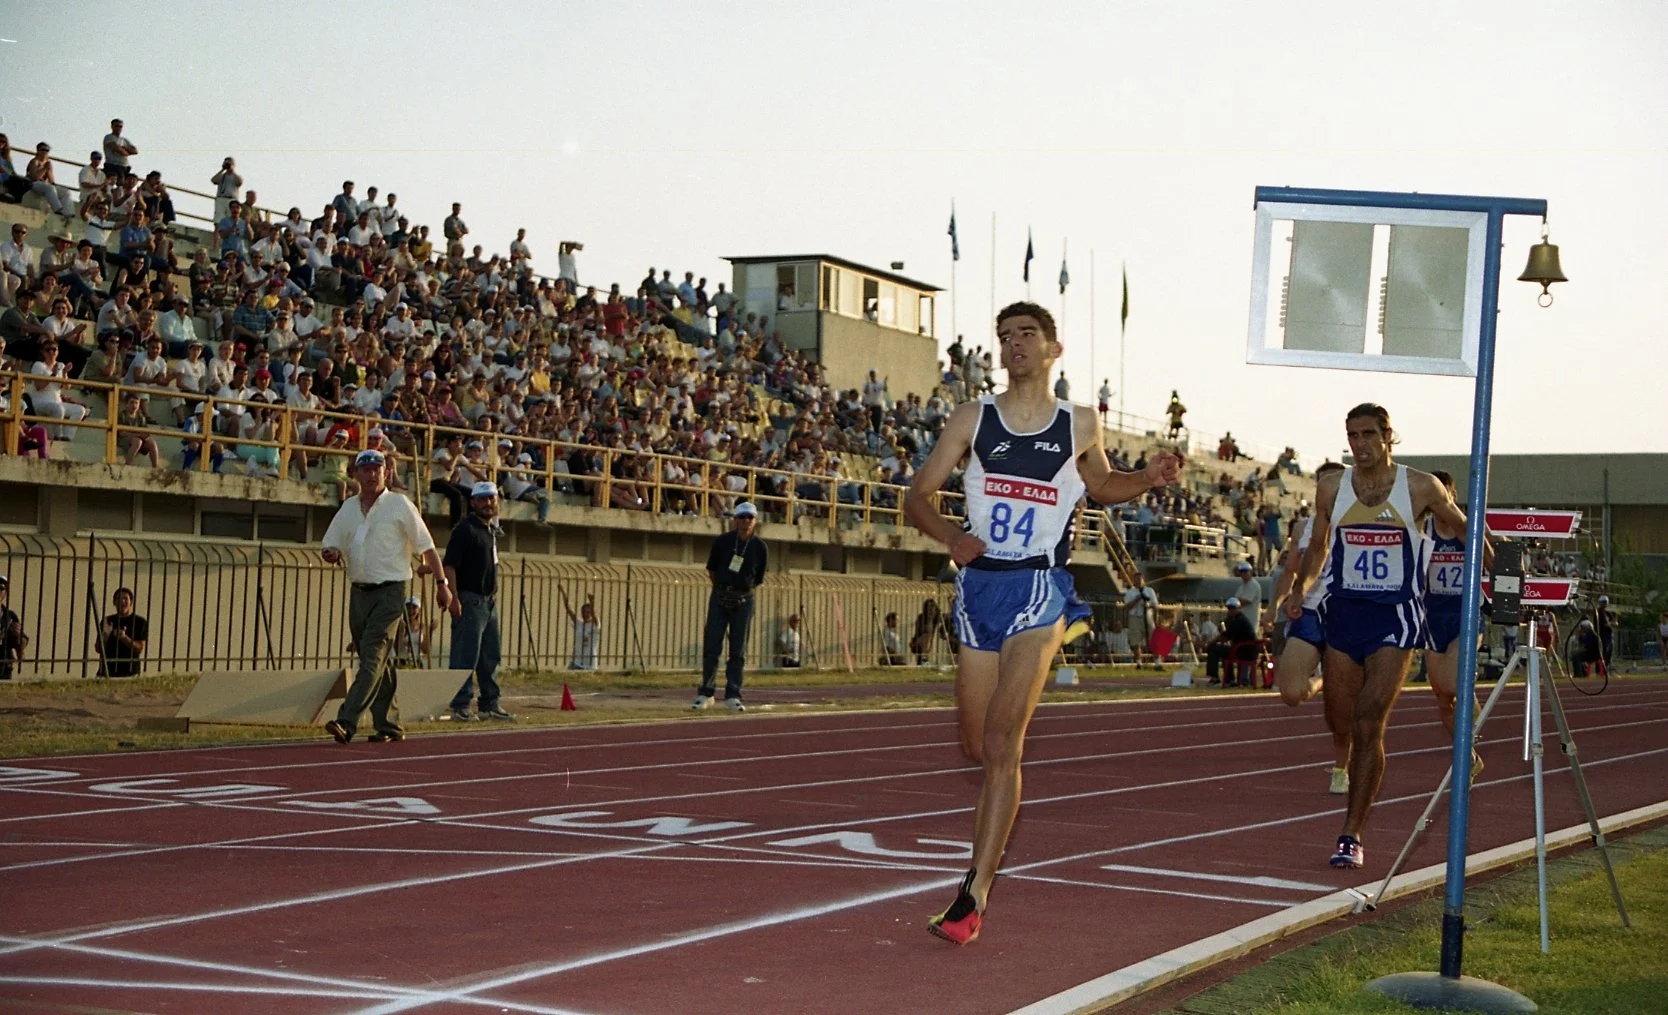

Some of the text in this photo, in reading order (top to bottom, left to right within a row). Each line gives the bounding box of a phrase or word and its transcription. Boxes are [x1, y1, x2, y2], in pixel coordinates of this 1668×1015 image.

[1034, 441, 1061, 453] FILA
[1023, 486, 1057, 502] ΕΛΔΑ
[990, 502, 1036, 548] 84
[1516, 523, 1545, 531] OMEGA
[1354, 549, 1389, 580] 46
[1436, 566, 1463, 588] 42
[1523, 590, 1542, 598] EGA
